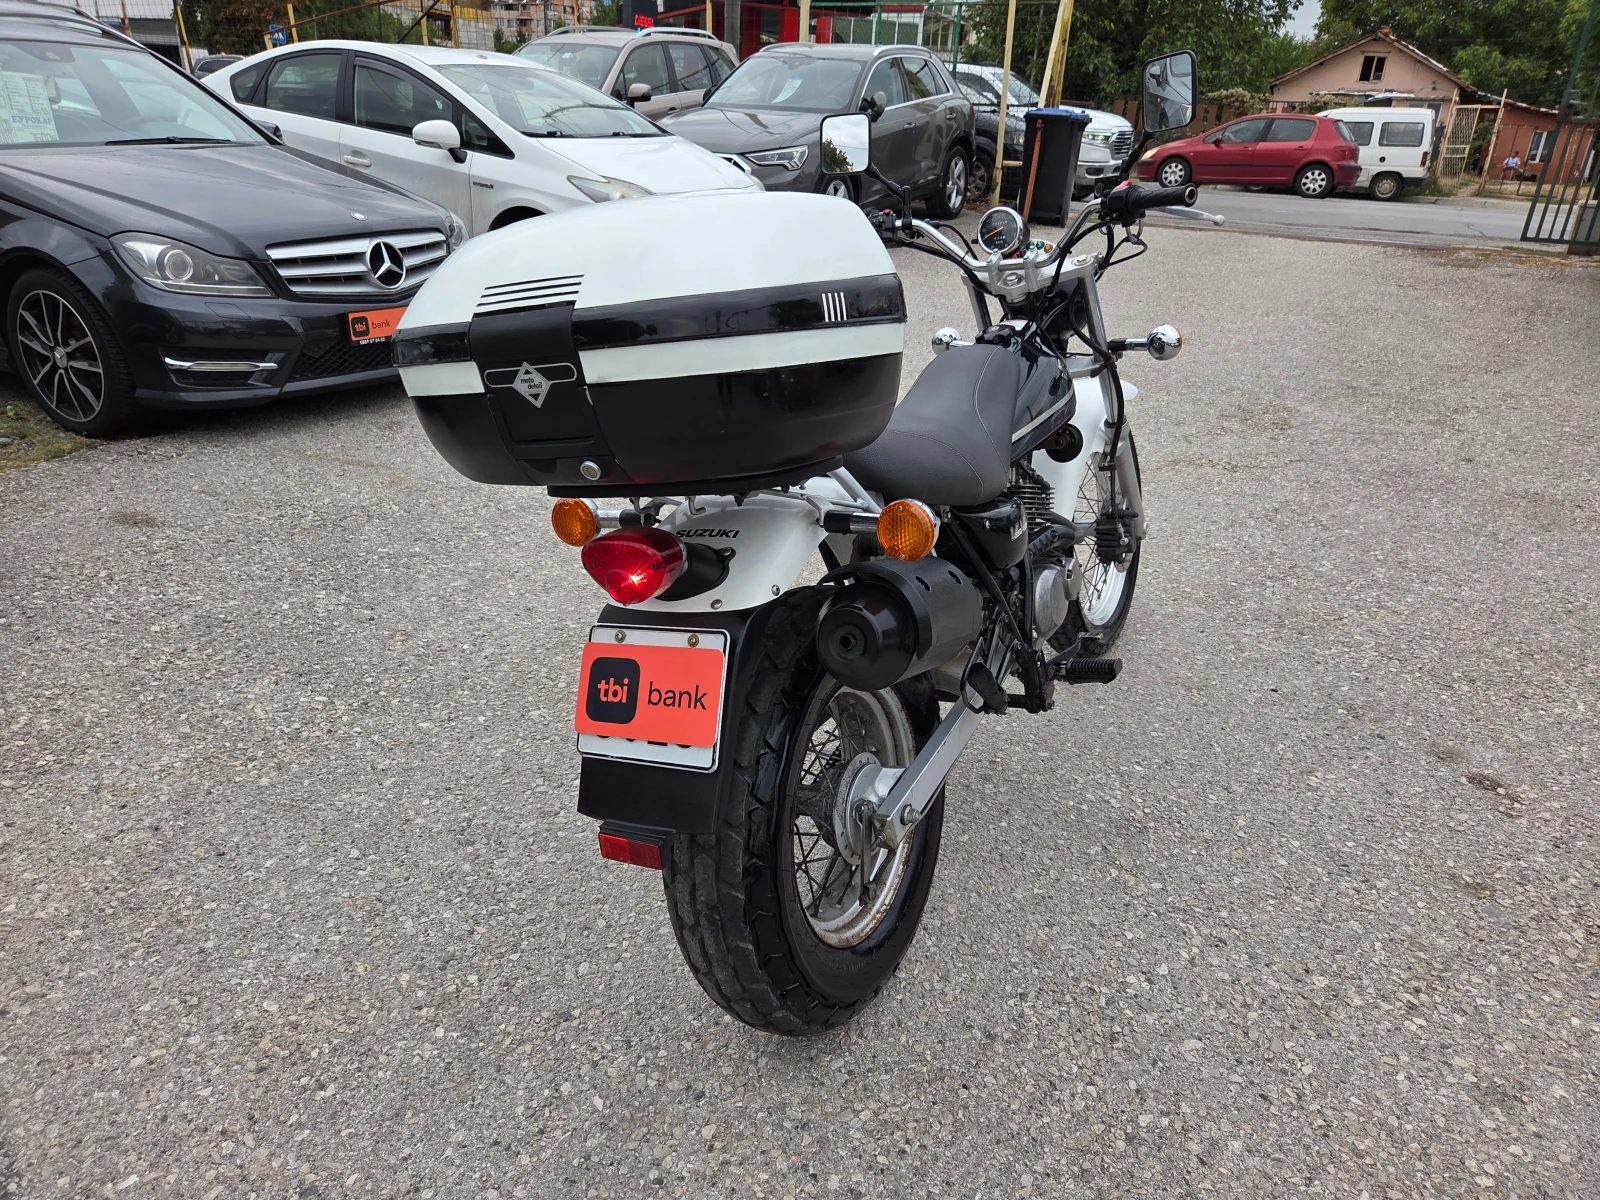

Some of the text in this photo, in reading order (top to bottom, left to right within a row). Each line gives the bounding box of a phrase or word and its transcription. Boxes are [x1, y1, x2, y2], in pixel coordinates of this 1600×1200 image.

[355, 319, 391, 331] tbi bank
[675, 528, 740, 539] SUZUKI
[597, 677, 708, 710] tbi bank
